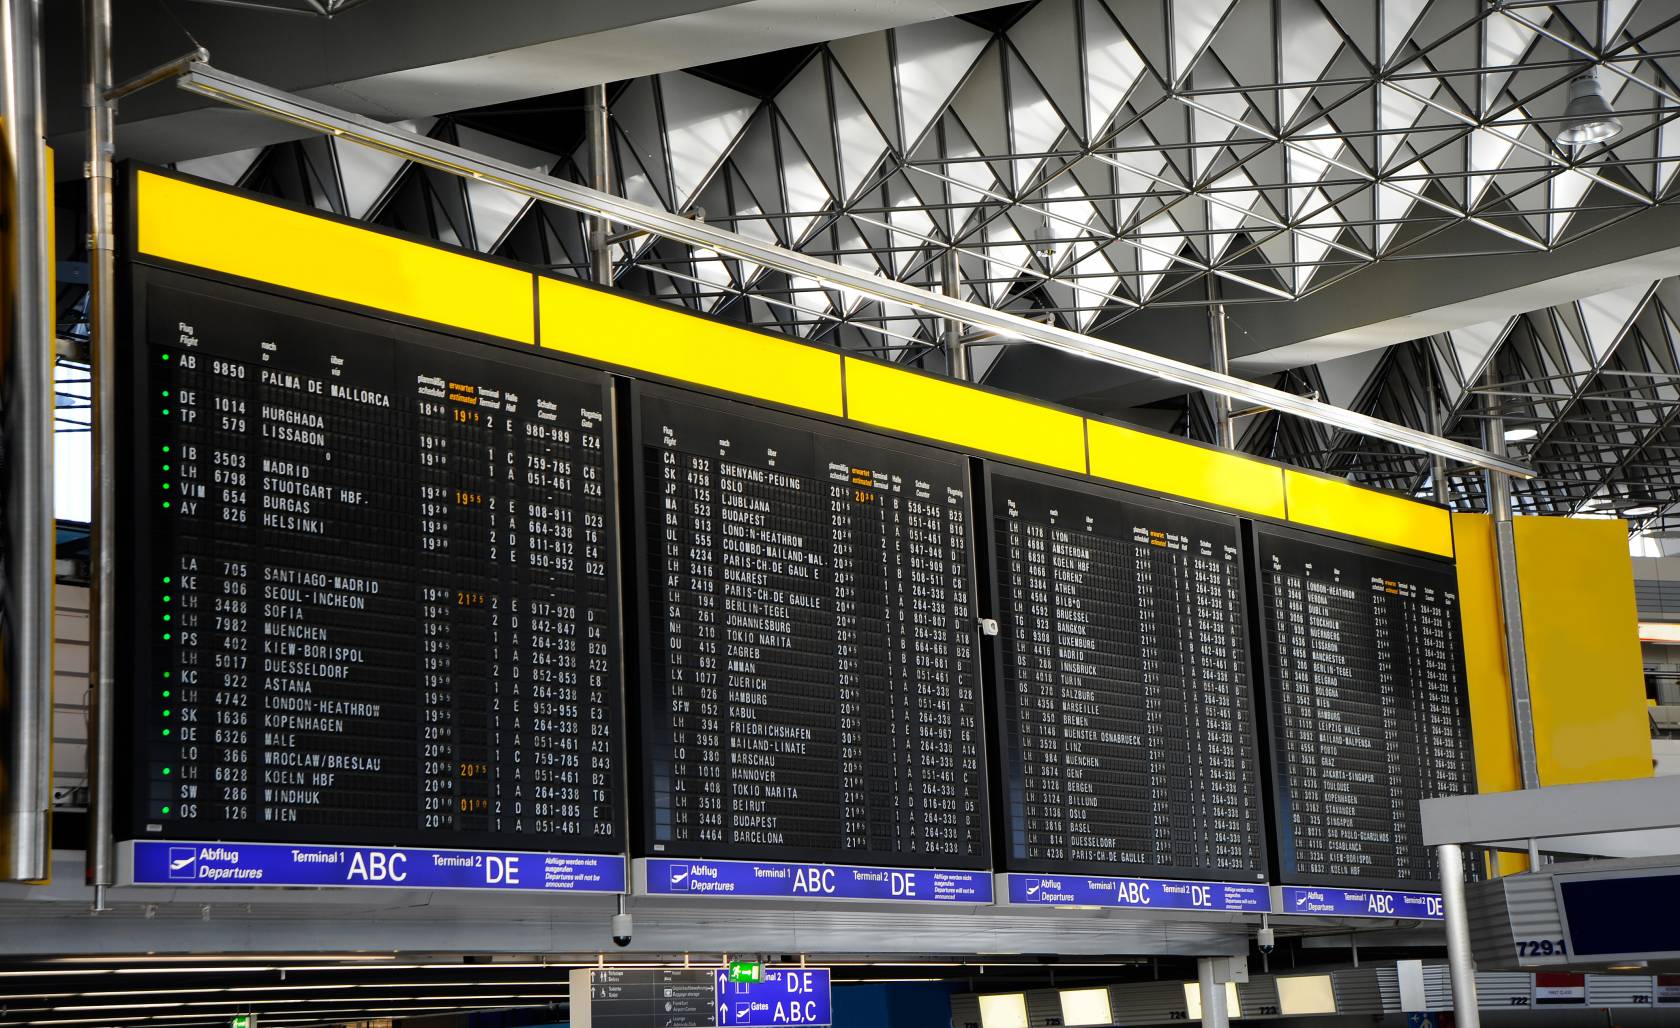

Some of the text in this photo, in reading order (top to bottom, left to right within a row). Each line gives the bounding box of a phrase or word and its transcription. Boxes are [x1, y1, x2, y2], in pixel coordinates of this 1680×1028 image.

[180, 354, 389, 407] AB 9850 PALMA DE MALLORCA
[180, 391, 324, 429] DE 1014 HURGHADA
[181, 409, 324, 446] TP 579 LISSABON
[182, 446, 309, 478] IB 3503 MADRID
[181, 465, 368, 504] LH 6798 STUOTGART HBF.
[721, 480, 742, 493] OSLO
[181, 483, 310, 513] VIM 654 BURGAS
[722, 494, 770, 512] LJUBLJANA
[181, 502, 324, 534] AY 826 HELSINKI
[722, 509, 765, 527] BUDAPEST
[1052, 530, 1068, 542] LYON
[182, 558, 378, 593] LA 705 SANTIAGO-MADRID
[725, 569, 768, 585] BUKAREST
[1055, 570, 1083, 583] FLORENZ
[182, 576, 364, 609] KE 906 SEOUL-INCHEON
[182, 596, 303, 619] LH 3488 SOFIA
[726, 600, 790, 618] BERLIN-TEGEL
[1057, 608, 1088, 622] BRUESSEL
[182, 615, 327, 641] LH 7982 MUENCHEN
[727, 615, 791, 633] JOHANNESBURG
[1058, 623, 1086, 635] BANGKOK
[182, 632, 363, 662] PS 402 KIEW-BORISPOL
[727, 630, 791, 648] TOKIO NARITA
[728, 645, 760, 659] ZAGREB
[1059, 649, 1083, 660] MADRID
[182, 652, 349, 678] LH 5017 DUESSELDORF
[728, 661, 755, 674] AMMAN
[1061, 662, 1096, 675] INNSBRUCK
[182, 670, 311, 693] KC 922 ASTANA
[729, 676, 767, 690] ZUERICH
[182, 690, 380, 717] LH 4742 LONDON-HEATHROW
[729, 692, 767, 705] HAMBURG
[181, 709, 343, 732] SK 1636 KOPENHAGEN
[730, 707, 756, 719] KABUL
[181, 728, 295, 747] DE 6326 MALE
[731, 722, 810, 740] FRIEDRICHSHAFEN
[731, 738, 805, 754] MAILAND-LINATE
[182, 748, 380, 771] LO 366 WROCLAW/BRESLAU
[731, 753, 775, 766] WARSCHAU
[182, 767, 335, 786] LH 6828 KOELN HBF
[732, 769, 775, 782] HANNOVER
[181, 786, 319, 804] SW 286 WINDHUK
[181, 805, 296, 821] OS 126 WIEN
[733, 800, 766, 812] BEIRUT
[734, 816, 777, 828] BUDAPEST
[734, 831, 783, 844] BARCELONA
[200, 848, 239, 862] Abflug
[200, 866, 262, 880] Departures
[292, 851, 406, 881] Terminal 1 ABC
[433, 855, 519, 884] Terminal 2 DE
[691, 865, 717, 878] Abflug
[691, 880, 734, 892] Departures
[754, 867, 835, 893] Terminal 1 ABC
[853, 871, 916, 896] Terminal 2 DE
[1041, 880, 1061, 890] Abflug
[1042, 892, 1074, 901] Departures
[1088, 881, 1112, 889] Terminal
[1118, 882, 1150, 904] ABC
[1162, 885, 1185, 893] Terminal
[1192, 886, 1211, 906] DE
[1308, 892, 1323, 901] Abflug
[1308, 903, 1334, 911] Departures
[1344, 893, 1363, 901] Terminal
[1368, 894, 1394, 913] ABC
[1404, 896, 1422, 904] Terminal
[1427, 898, 1443, 915] DE
[1516, 940, 1566, 957] 729.1
[776, 973, 781, 982] 2
[787, 972, 813, 993] D,E
[1511, 997, 1527, 1005] 722
[751, 1001, 816, 1022] Gates A,B,C
